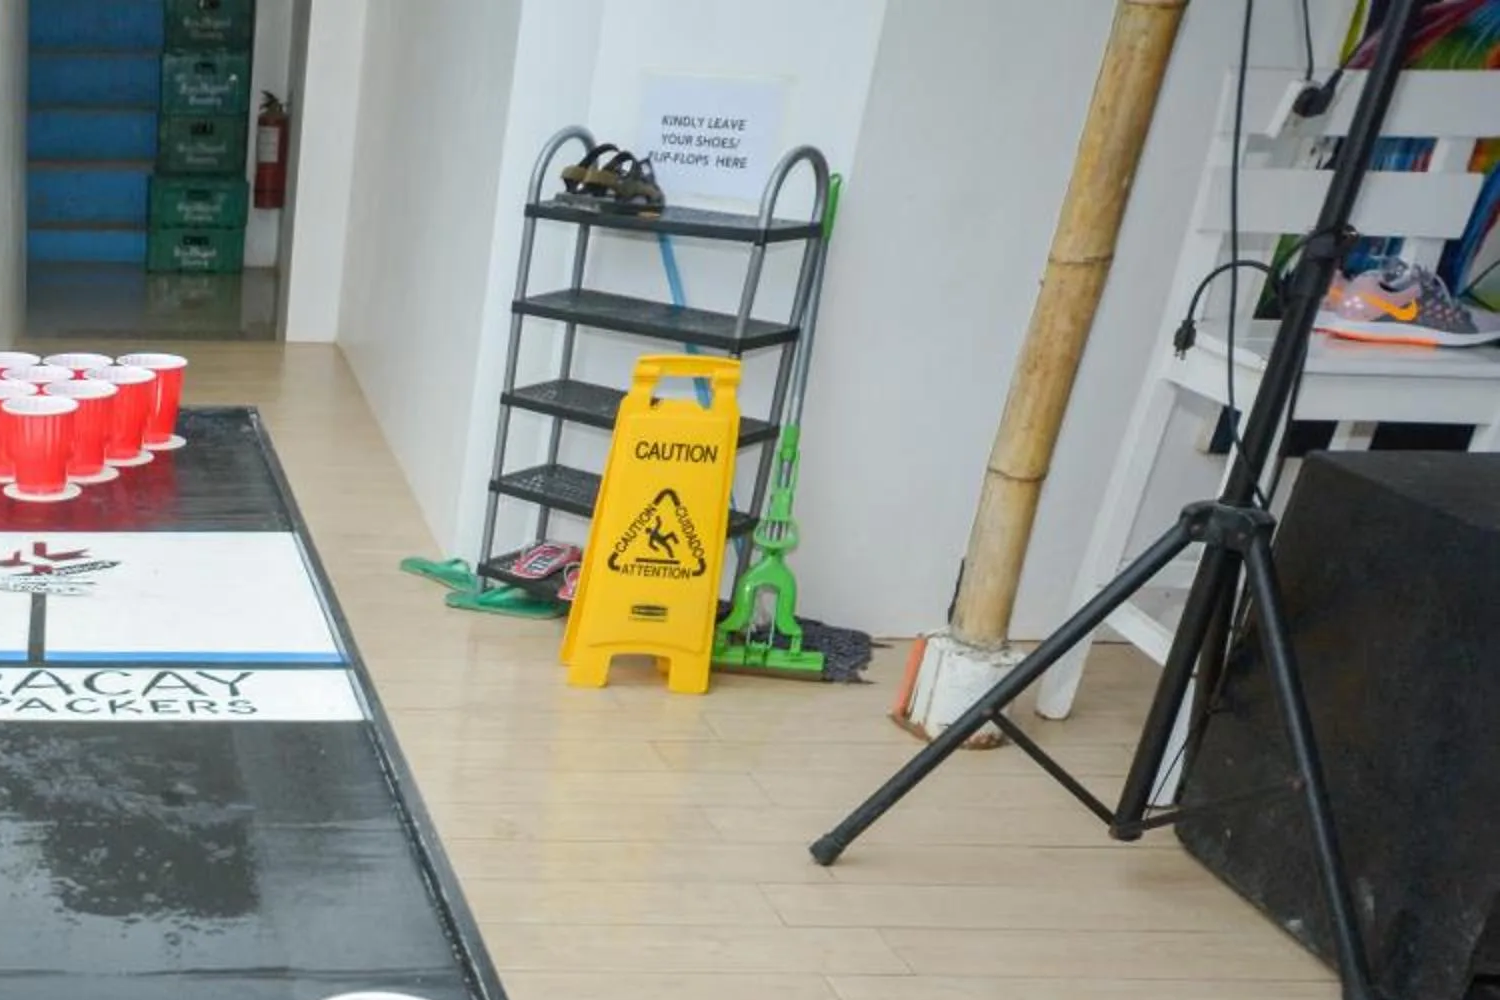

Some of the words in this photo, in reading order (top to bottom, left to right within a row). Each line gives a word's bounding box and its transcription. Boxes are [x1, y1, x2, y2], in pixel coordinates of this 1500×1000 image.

[661, 115, 705, 128] KINDLY
[707, 117, 747, 131] LEAVE
[661, 133, 693, 146] YOUR
[715, 155, 747, 169] HERE
[635, 440, 718, 464] CAUTION
[615, 504, 657, 553] CAUTION
[675, 505, 705, 560] CUIDADO
[621, 563, 691, 580] ATTENTION
